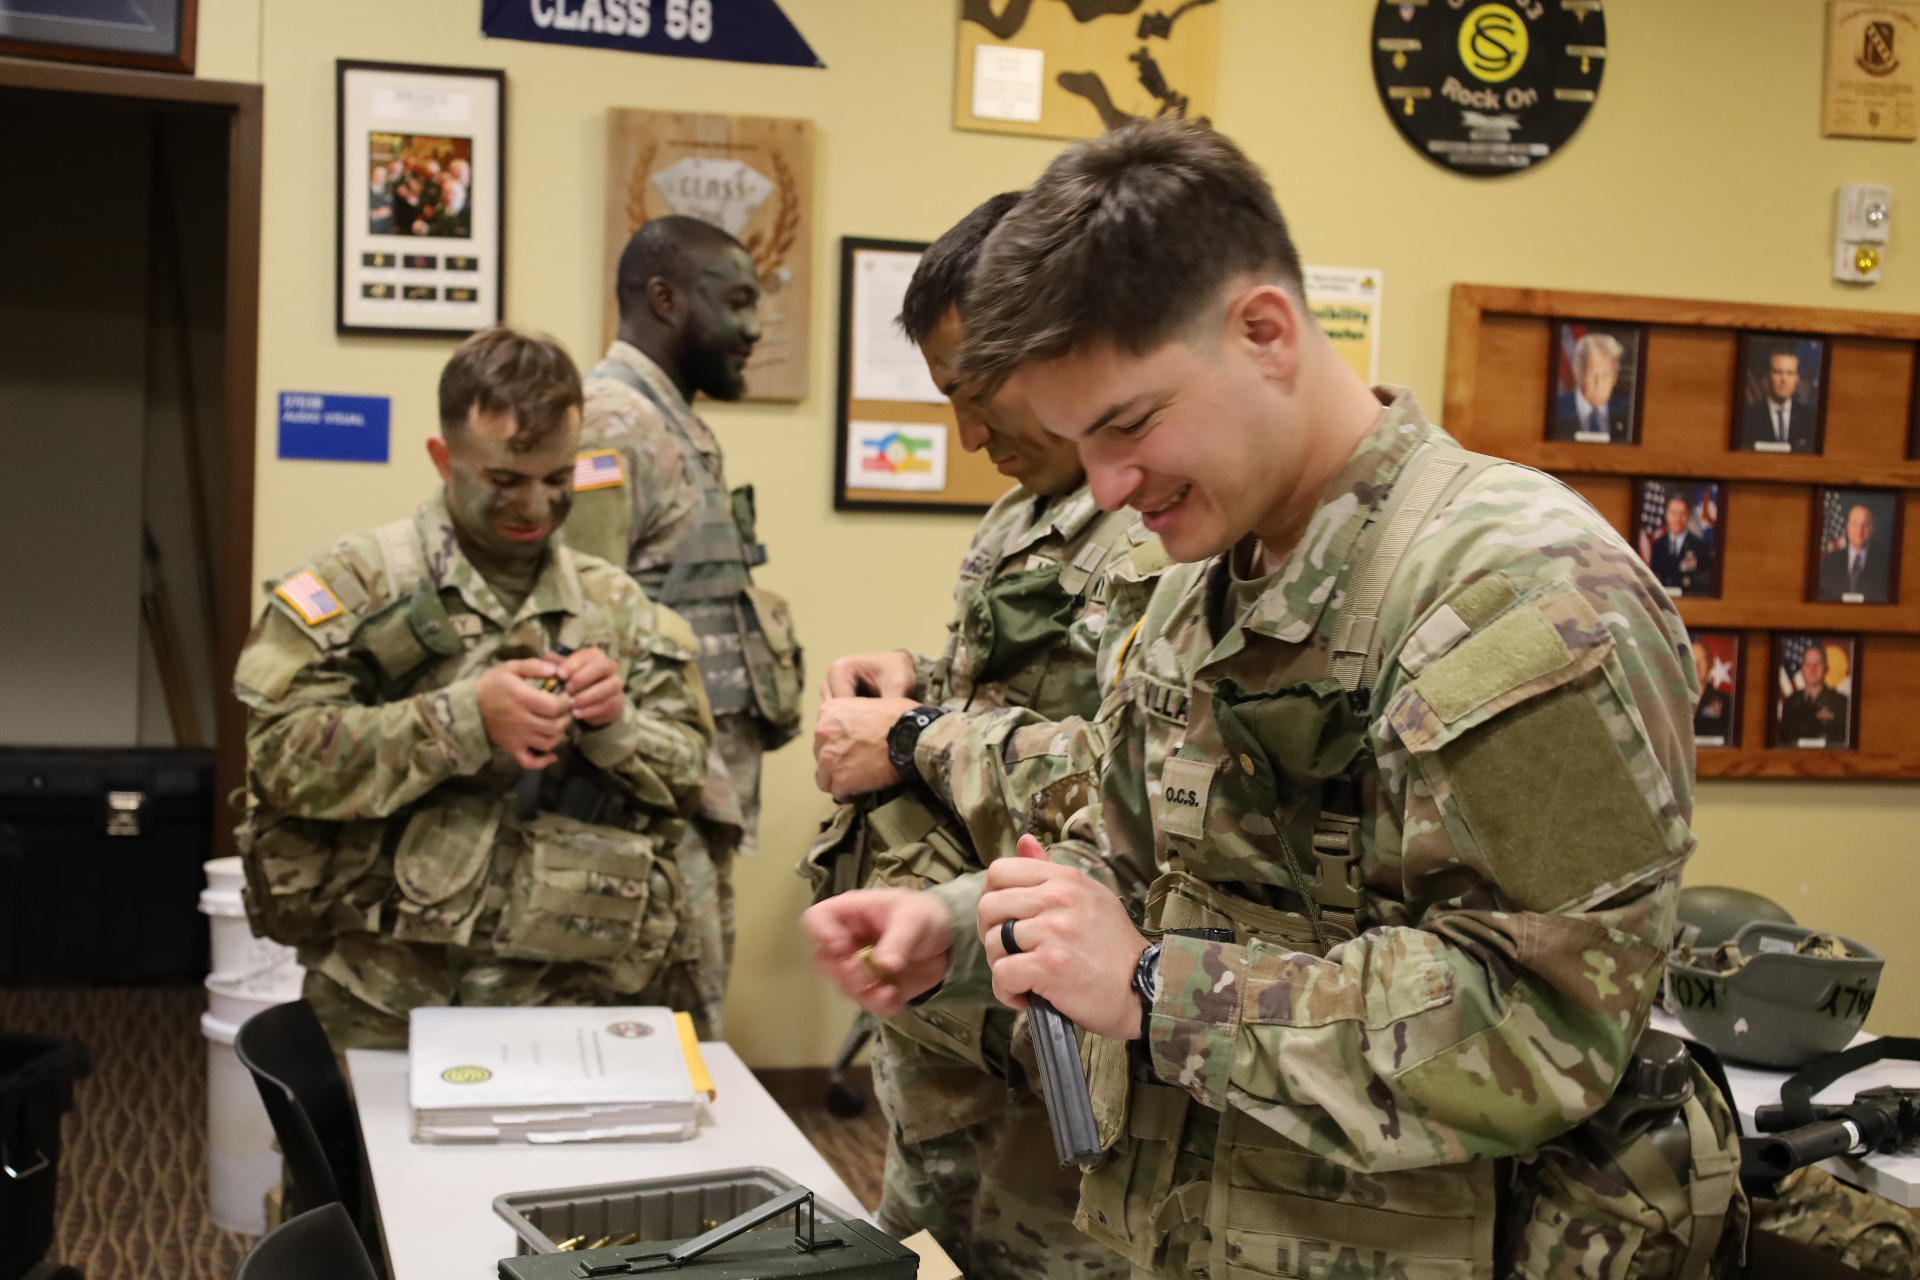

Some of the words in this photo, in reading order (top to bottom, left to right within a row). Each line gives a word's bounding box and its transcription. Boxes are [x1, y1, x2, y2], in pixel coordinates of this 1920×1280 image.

[530, 0, 650, 38] CLASS
[665, 0, 713, 43] 58
[1440, 76, 1500, 110] Rock
[1504, 87, 1539, 109] On
[1166, 786, 1199, 808] O.C.S.
